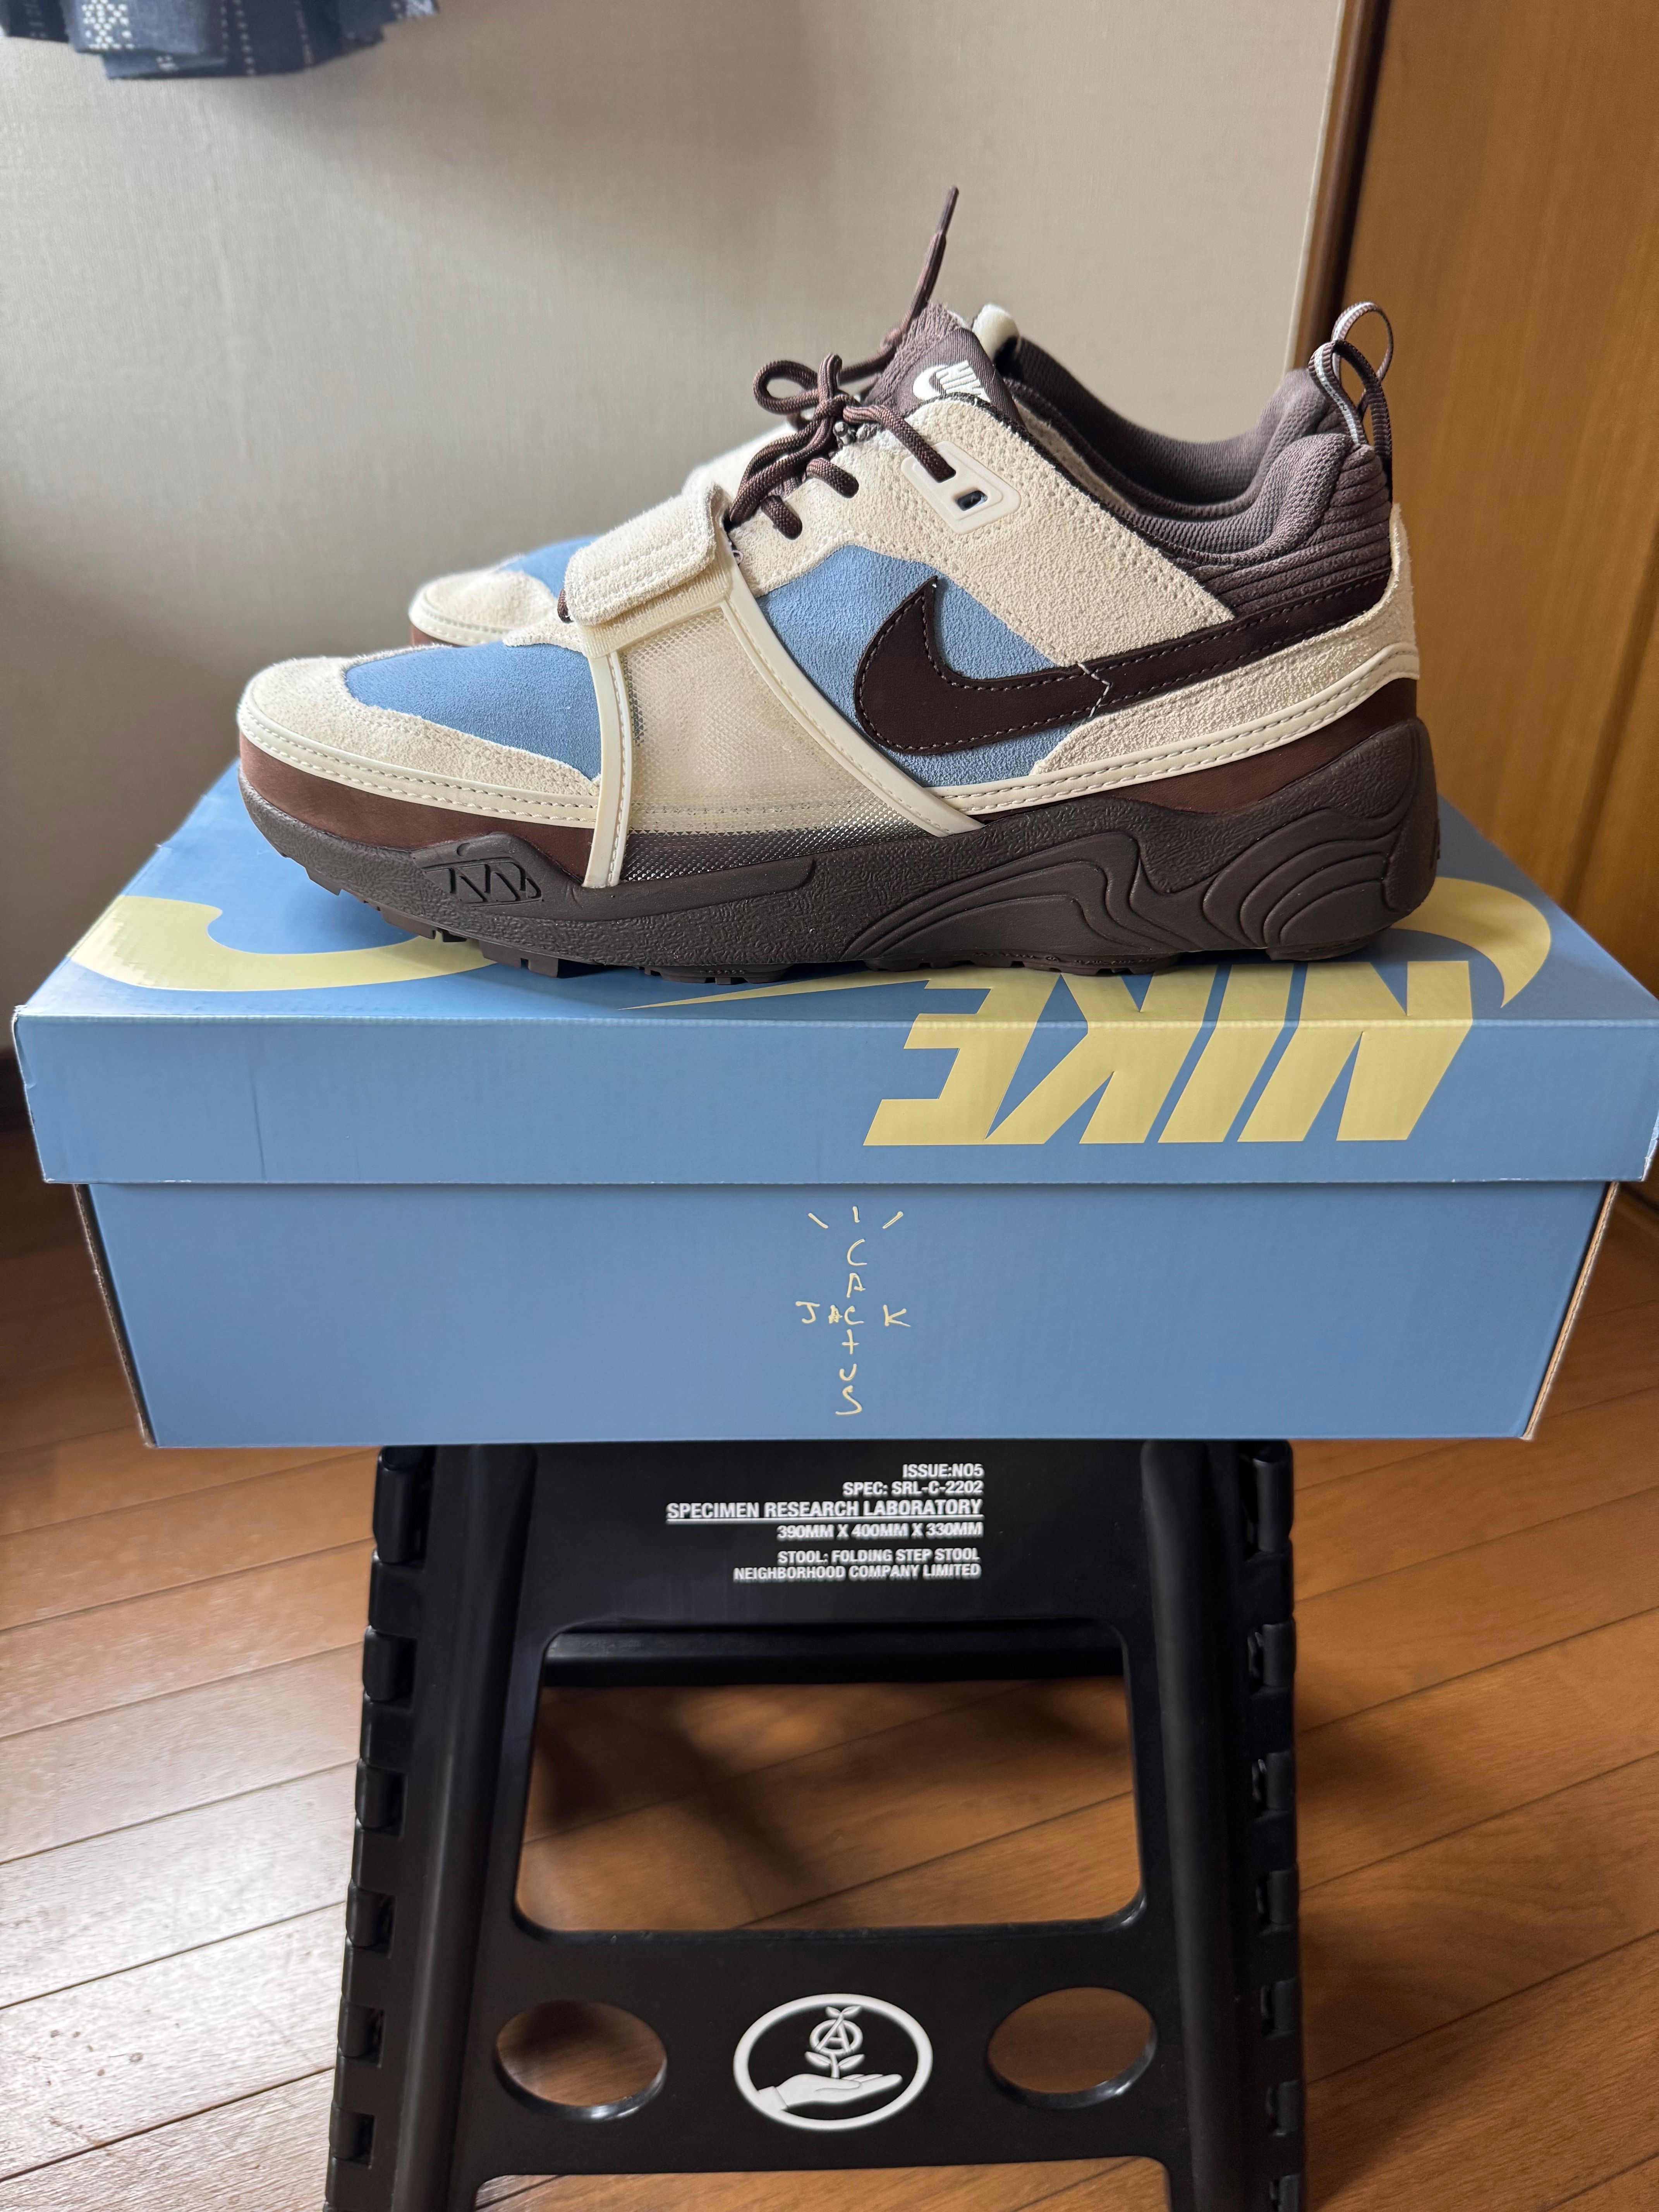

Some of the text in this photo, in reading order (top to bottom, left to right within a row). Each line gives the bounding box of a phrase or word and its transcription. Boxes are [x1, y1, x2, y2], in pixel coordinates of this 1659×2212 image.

[863, 961, 1473, 1146] NIKE
[795, 1301, 911, 1327] JACK
[843, 1480, 984, 1497] SPEC: SRL-C-2202
[666, 1499, 982, 1518] SPECIMEN RESEARCH LABORATORY
[777, 1522, 983, 1539] 390MM X 400MM X 330MM
[778, 1548, 980, 1565] STOOL: FOLDING STEP STOOL
[733, 1564, 981, 1582] NEIGHBORHOOD COMPANY LIMITED
